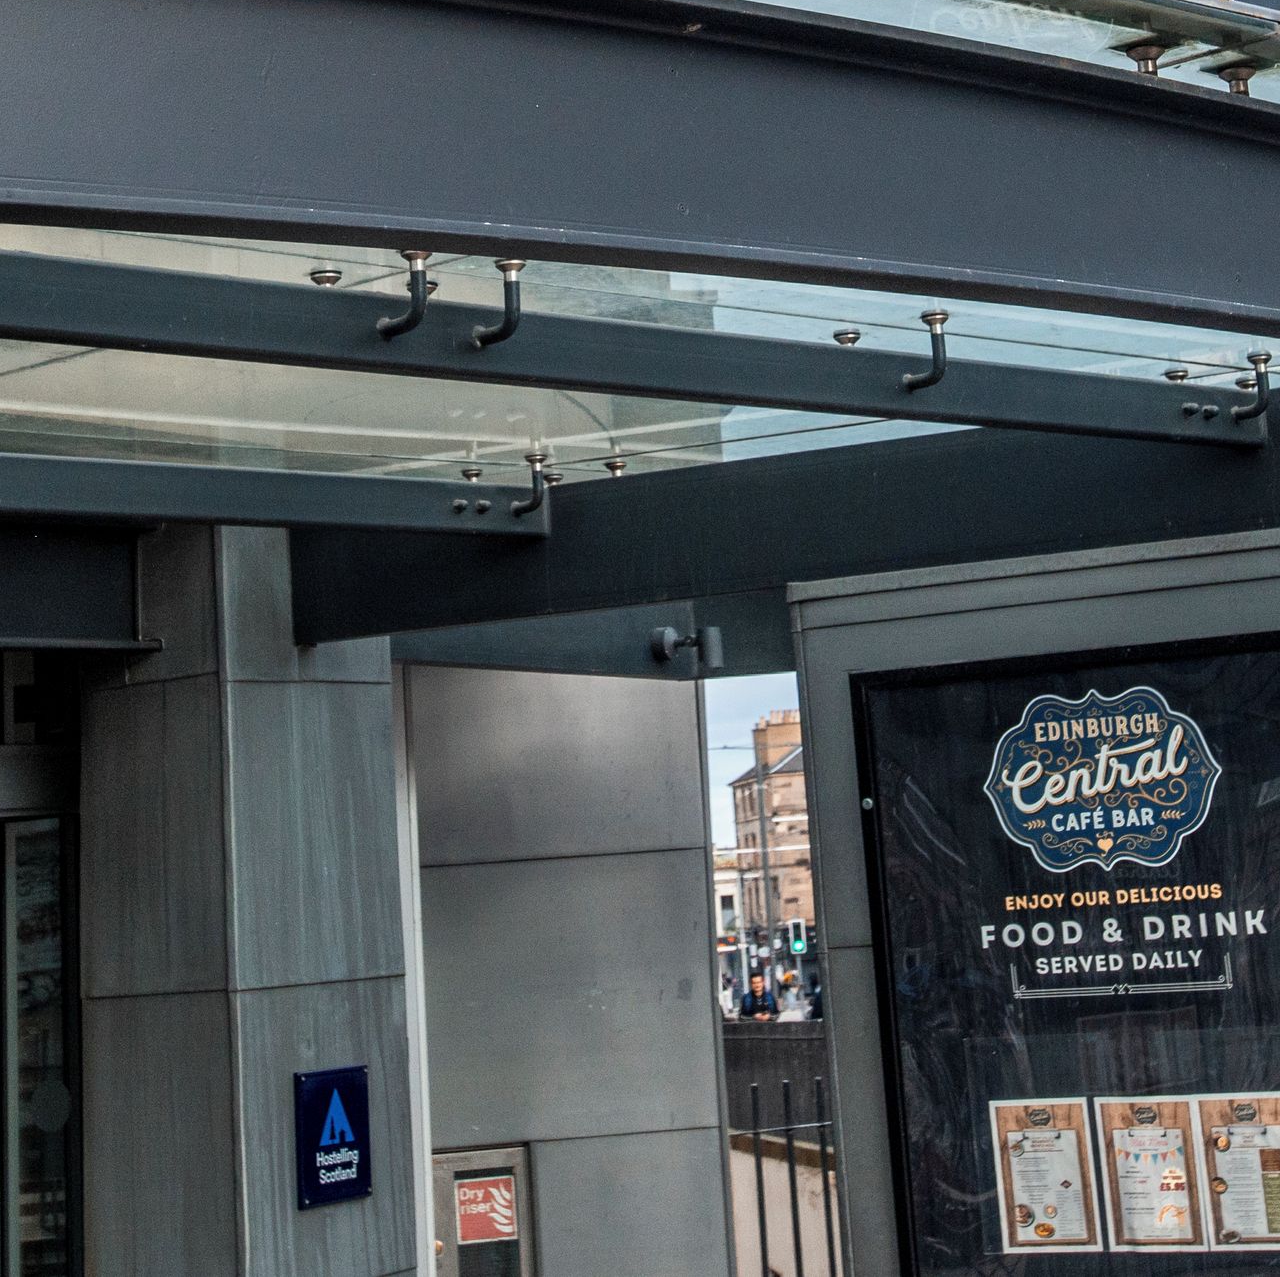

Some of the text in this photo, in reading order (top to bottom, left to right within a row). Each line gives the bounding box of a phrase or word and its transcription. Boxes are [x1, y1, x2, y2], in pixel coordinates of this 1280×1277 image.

[1033, 712, 1160, 743] EDINBURGH
[1001, 723, 1190, 813] Central
[1051, 807, 1155, 832] CAFÉ BAR
[1005, 883, 1223, 911] ENJOY OUR DELICIOUS
[980, 910, 1268, 949] FOOD & DRINK
[1035, 949, 1203, 975] SERVED DAILY
[316, 1148, 359, 1168] Hostelling
[319, 1165, 357, 1185] Scotland
[459, 1186, 485, 1203] Dry
[460, 1199, 492, 1215] riser
